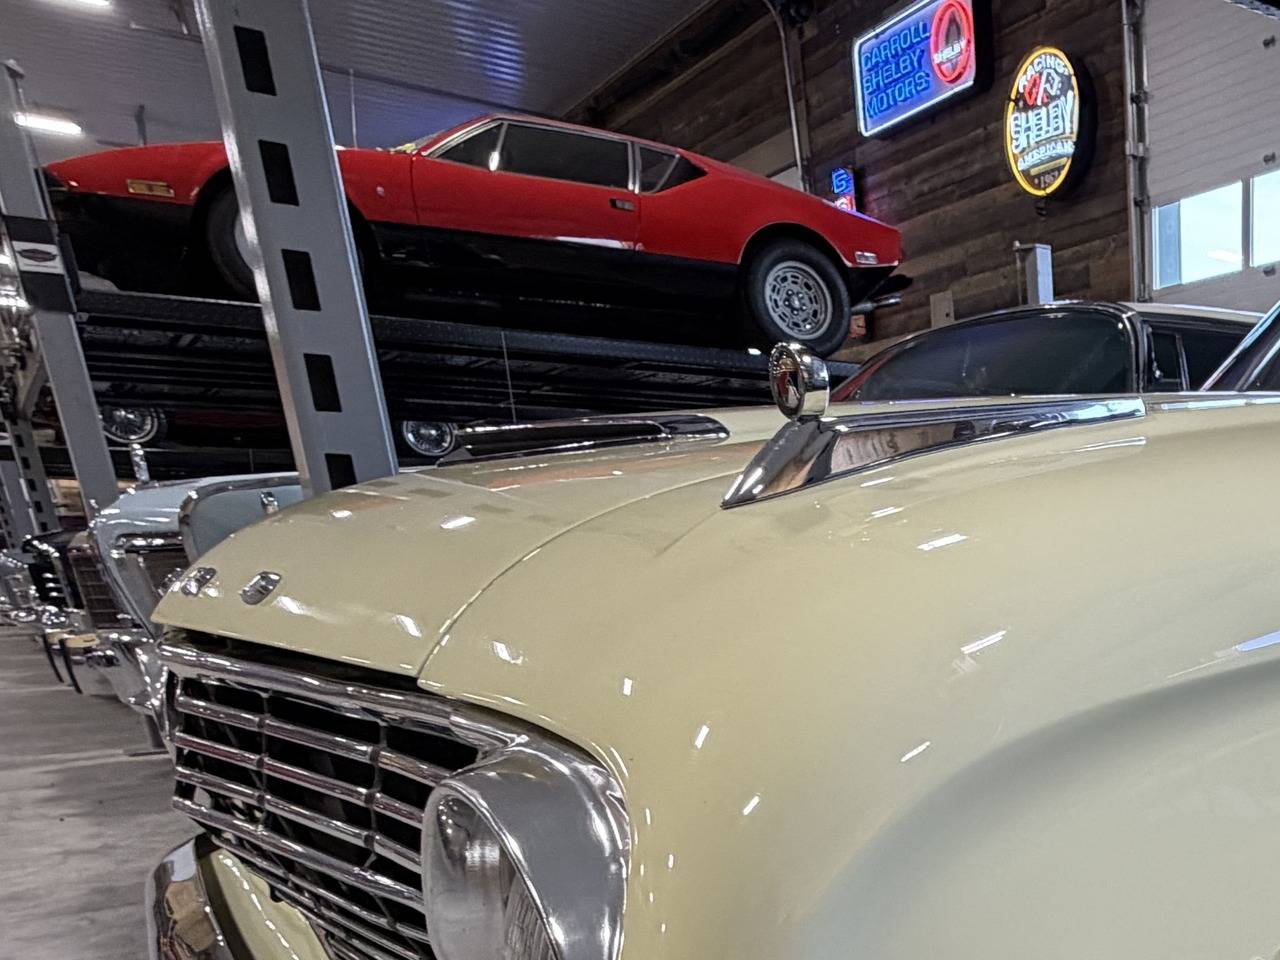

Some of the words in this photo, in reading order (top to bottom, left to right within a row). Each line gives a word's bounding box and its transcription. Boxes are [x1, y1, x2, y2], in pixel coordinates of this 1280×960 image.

[861, 22, 931, 69] CARROLL
[933, 38, 966, 64] SHELBY
[863, 49, 921, 93] SHELBY
[865, 71, 929, 117] MOTORS
[1011, 90, 1074, 153] SHELBY
